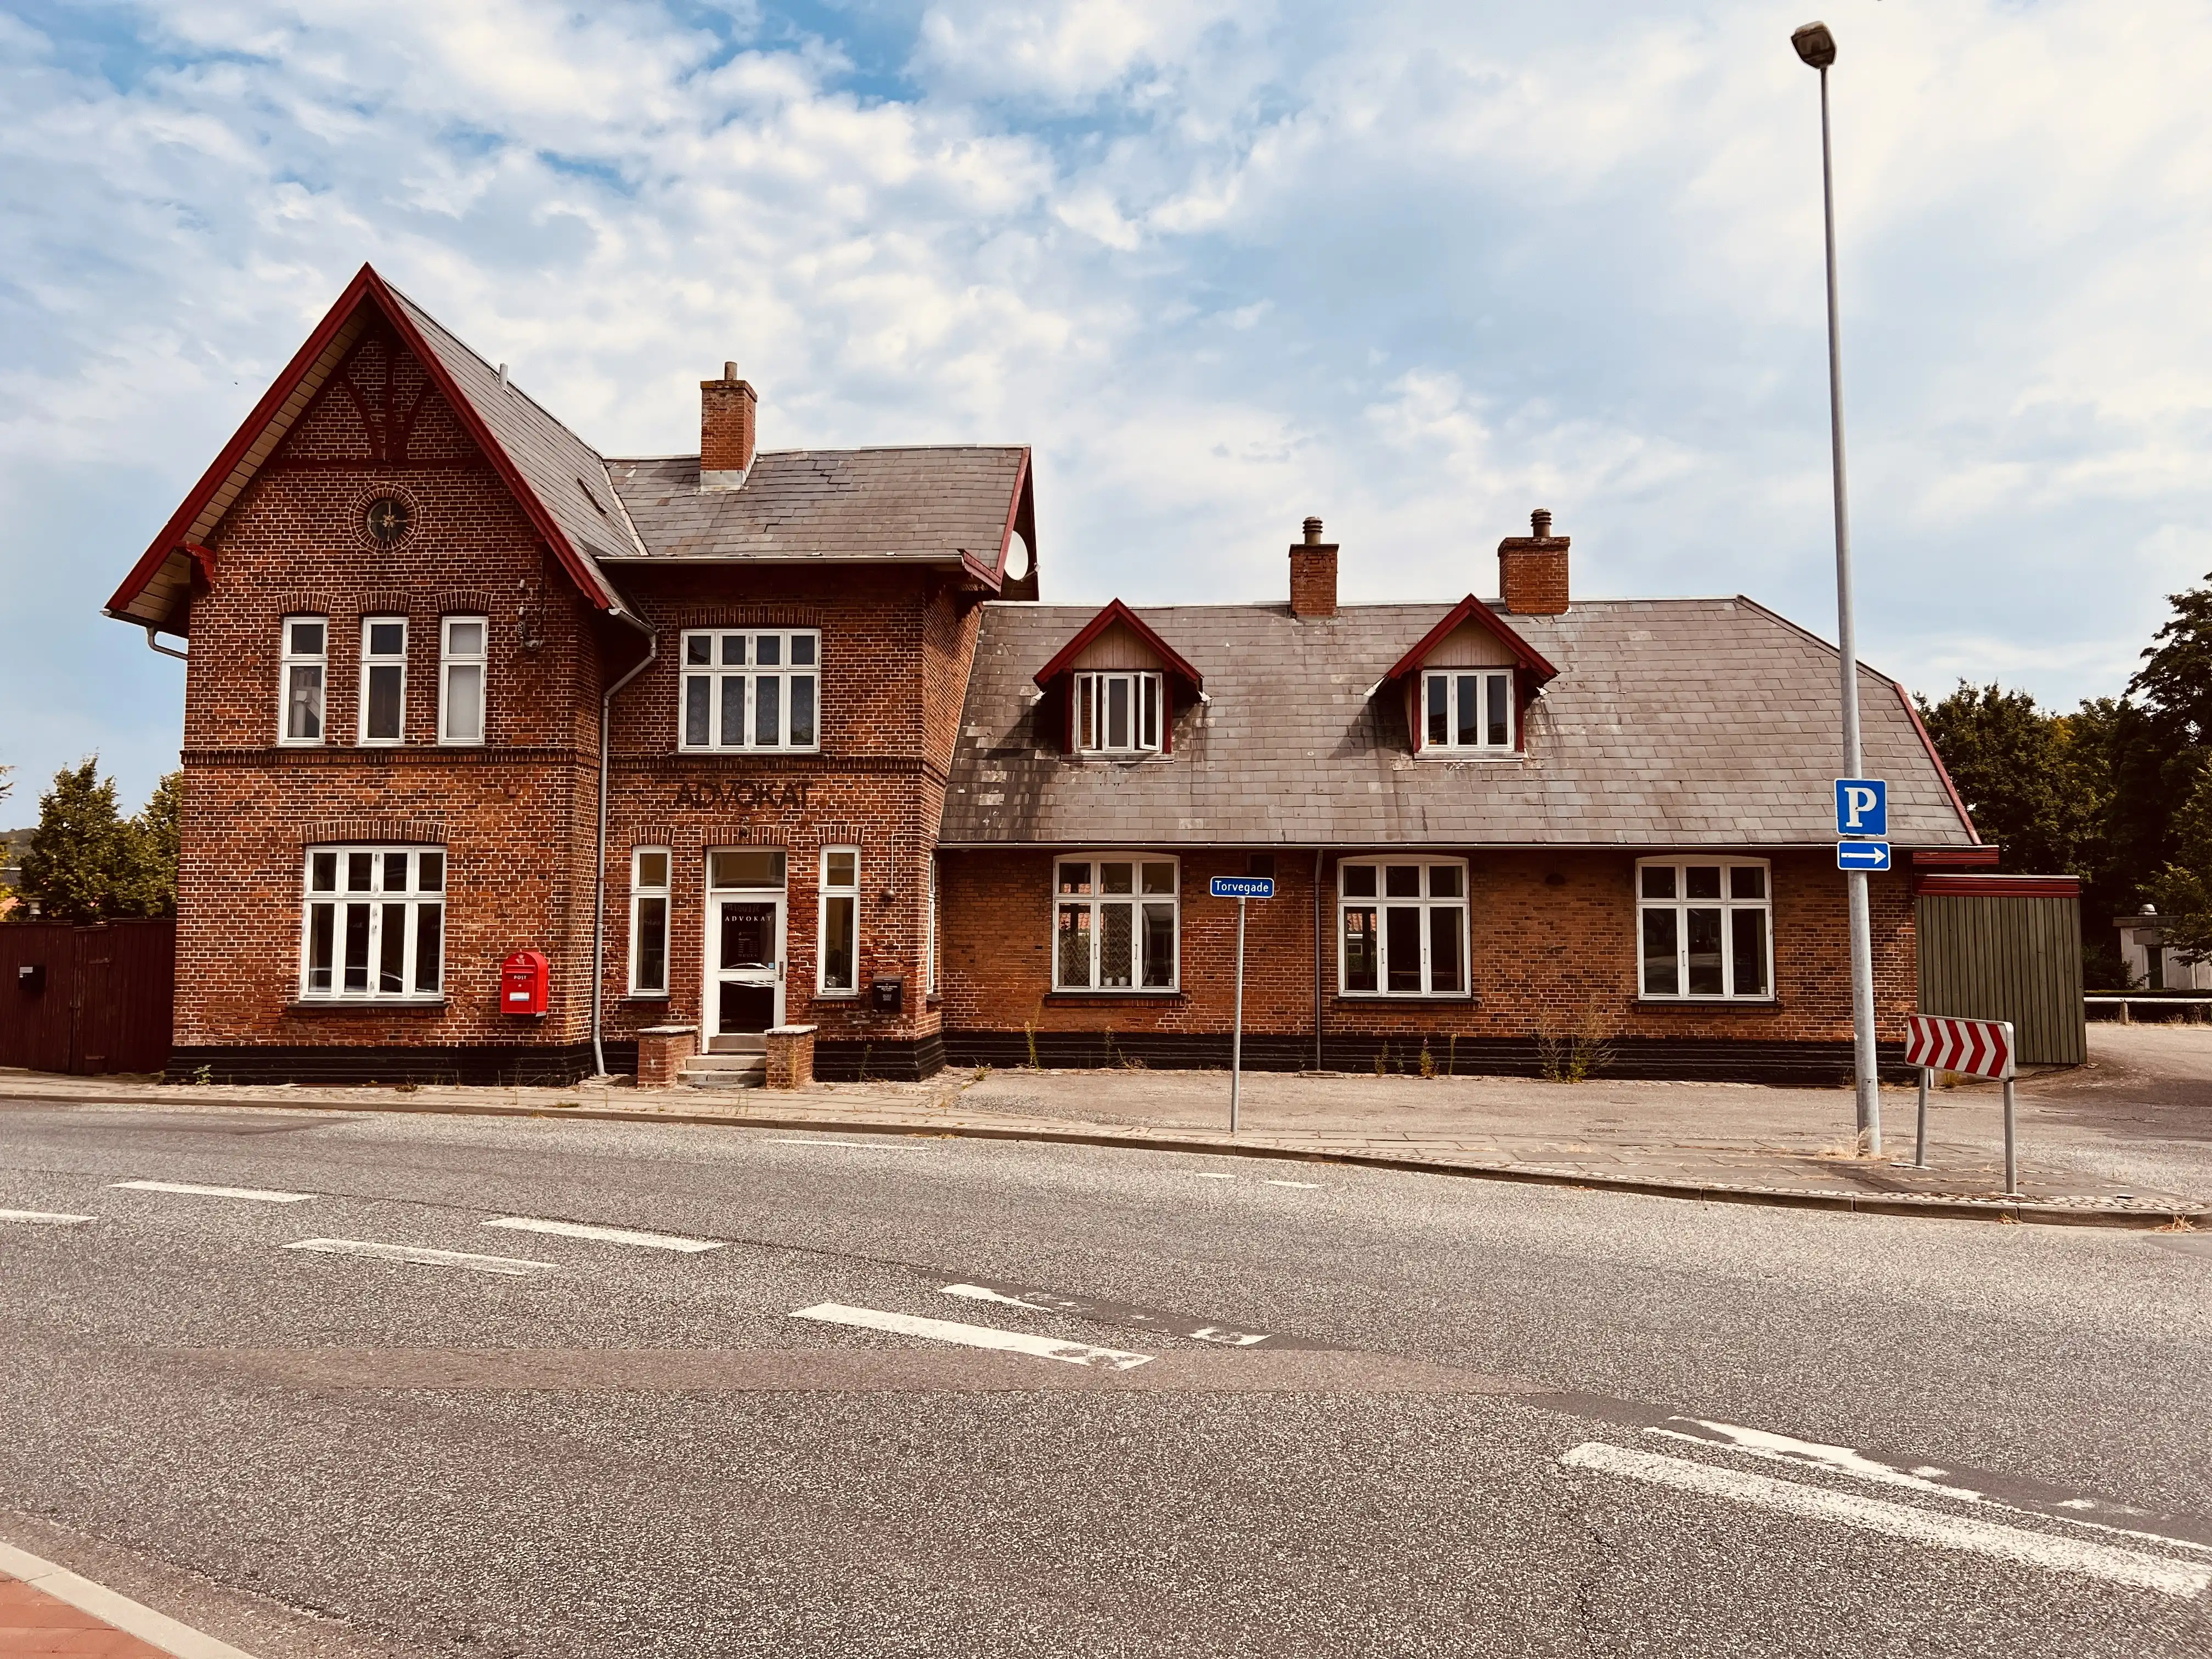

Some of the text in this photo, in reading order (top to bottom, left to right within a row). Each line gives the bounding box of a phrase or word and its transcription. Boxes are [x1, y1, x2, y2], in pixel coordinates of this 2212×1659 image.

[675, 780, 814, 809] ADVOKAT
[1844, 787, 1877, 827] P
[1215, 880, 1269, 895] Torvegade
